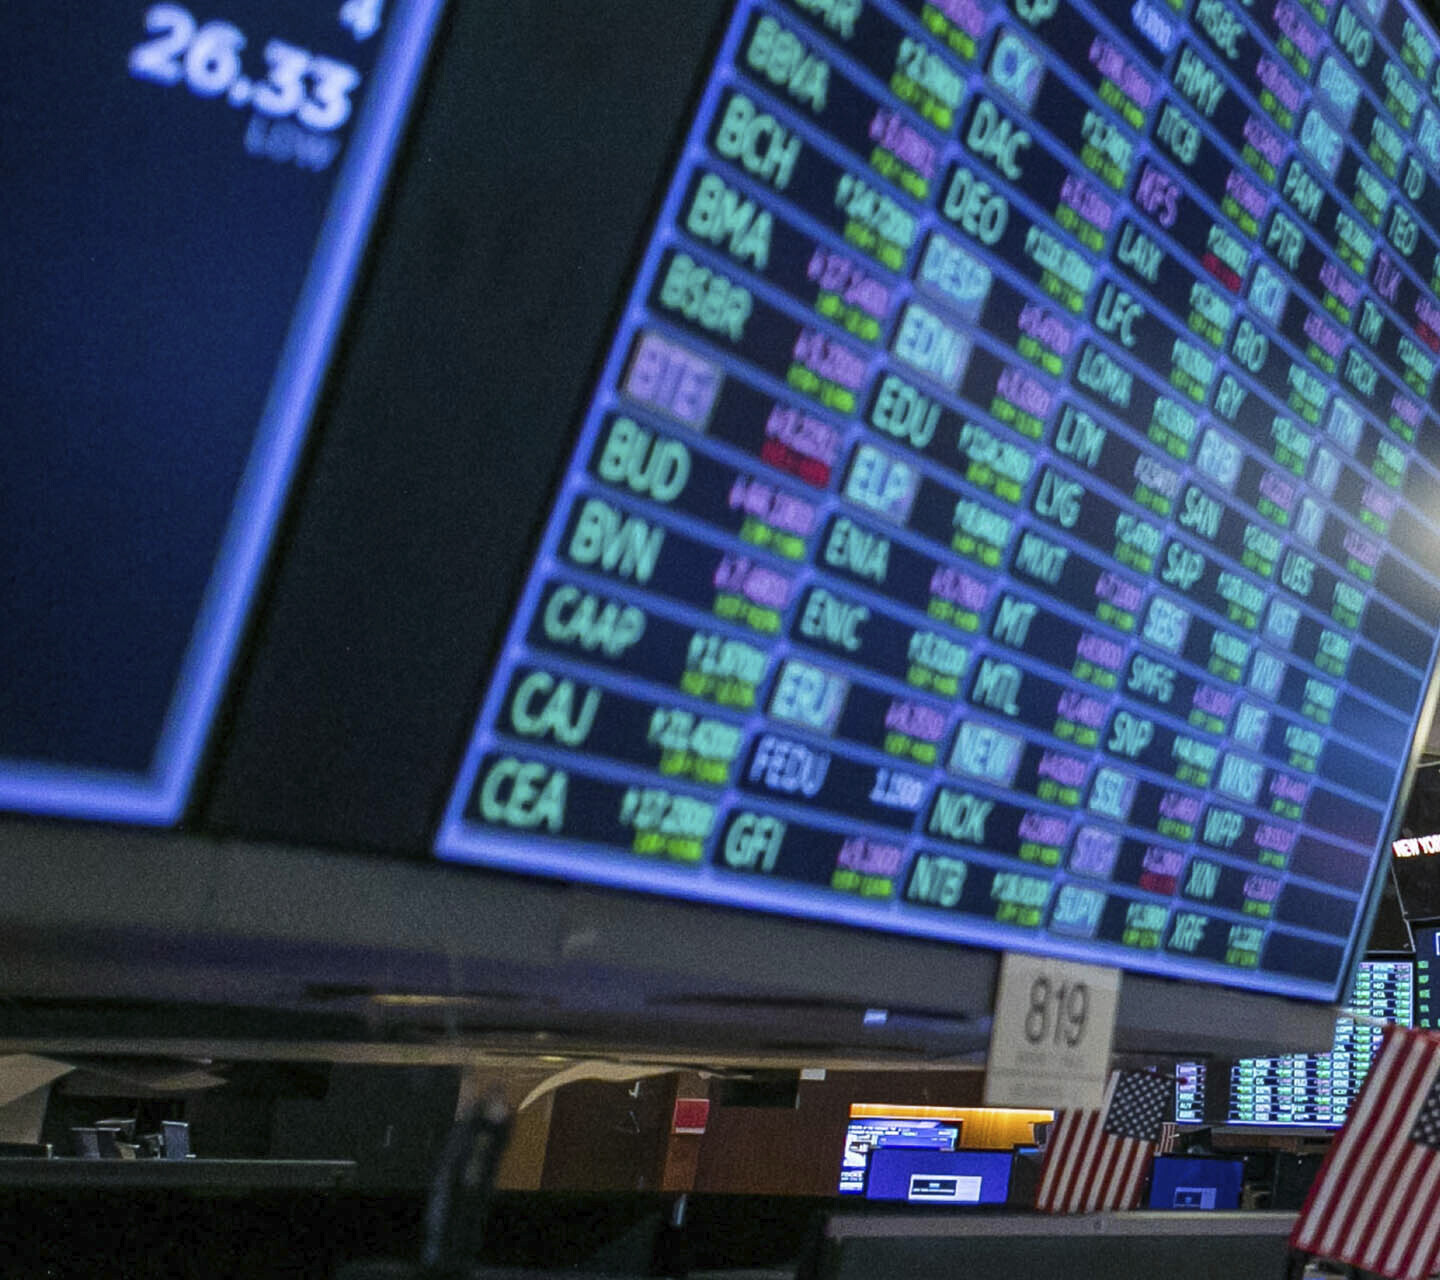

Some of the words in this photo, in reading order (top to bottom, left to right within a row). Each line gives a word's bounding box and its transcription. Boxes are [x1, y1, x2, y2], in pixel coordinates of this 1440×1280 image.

[129, 2, 360, 132] 26.33
[479, 757, 568, 833] CEA
[1392, 836, 1419, 858] NEW
[1023, 977, 1089, 1047] 819
